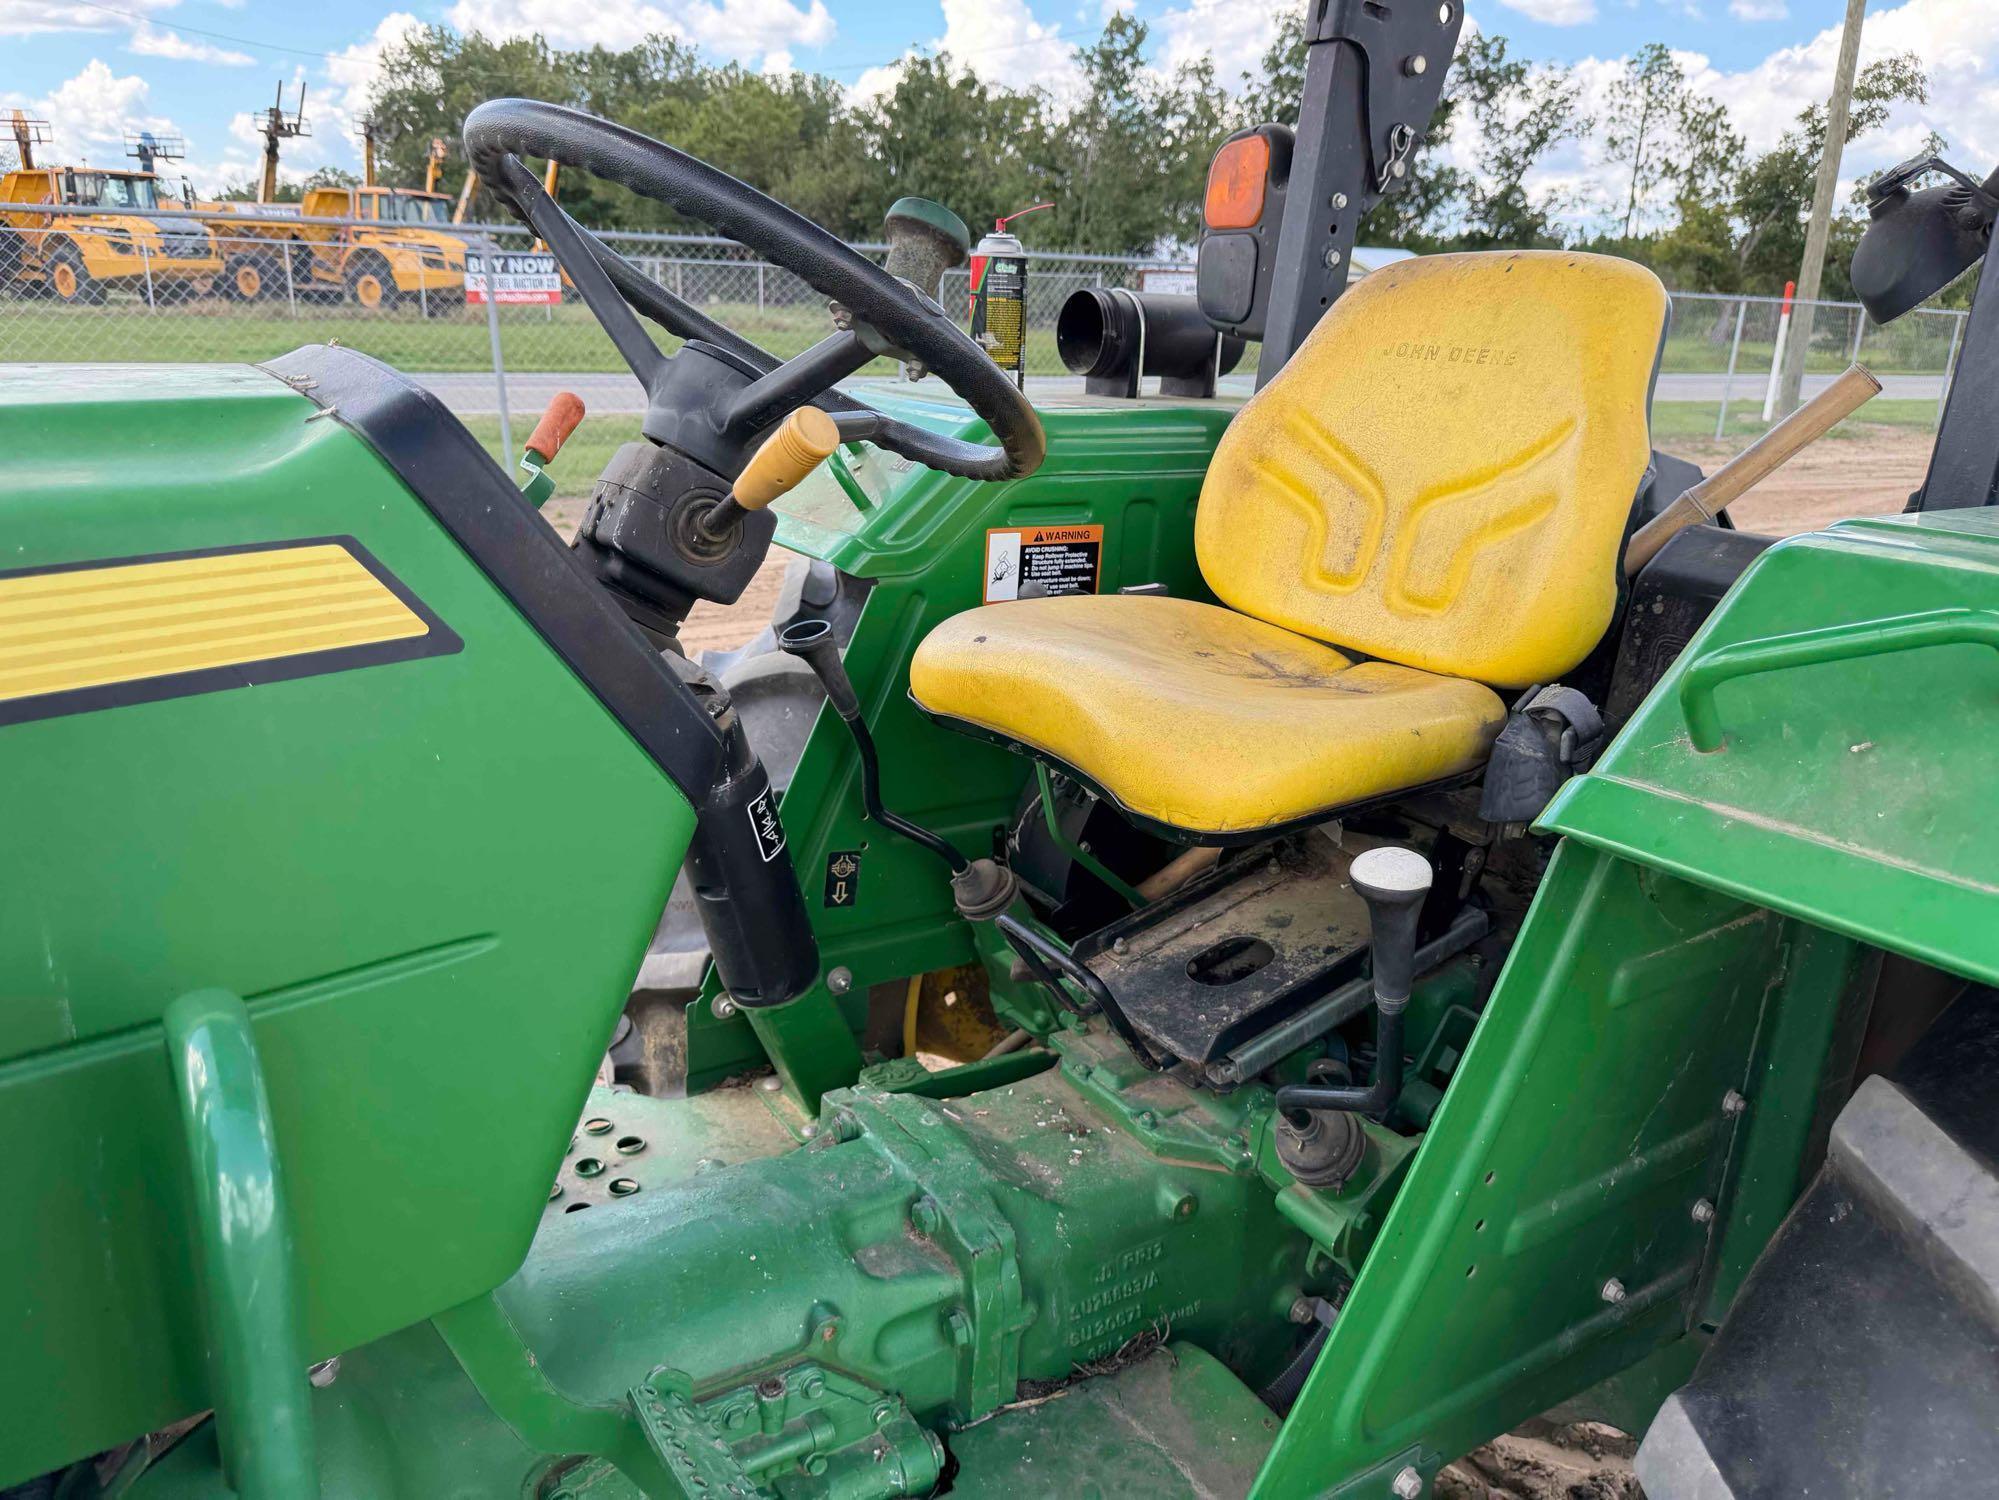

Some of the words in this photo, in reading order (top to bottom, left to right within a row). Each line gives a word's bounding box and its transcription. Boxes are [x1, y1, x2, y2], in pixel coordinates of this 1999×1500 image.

[508, 258, 555, 273] NOW
[1383, 343, 1440, 361] JOHN
[1046, 531, 1090, 540] WARNING
